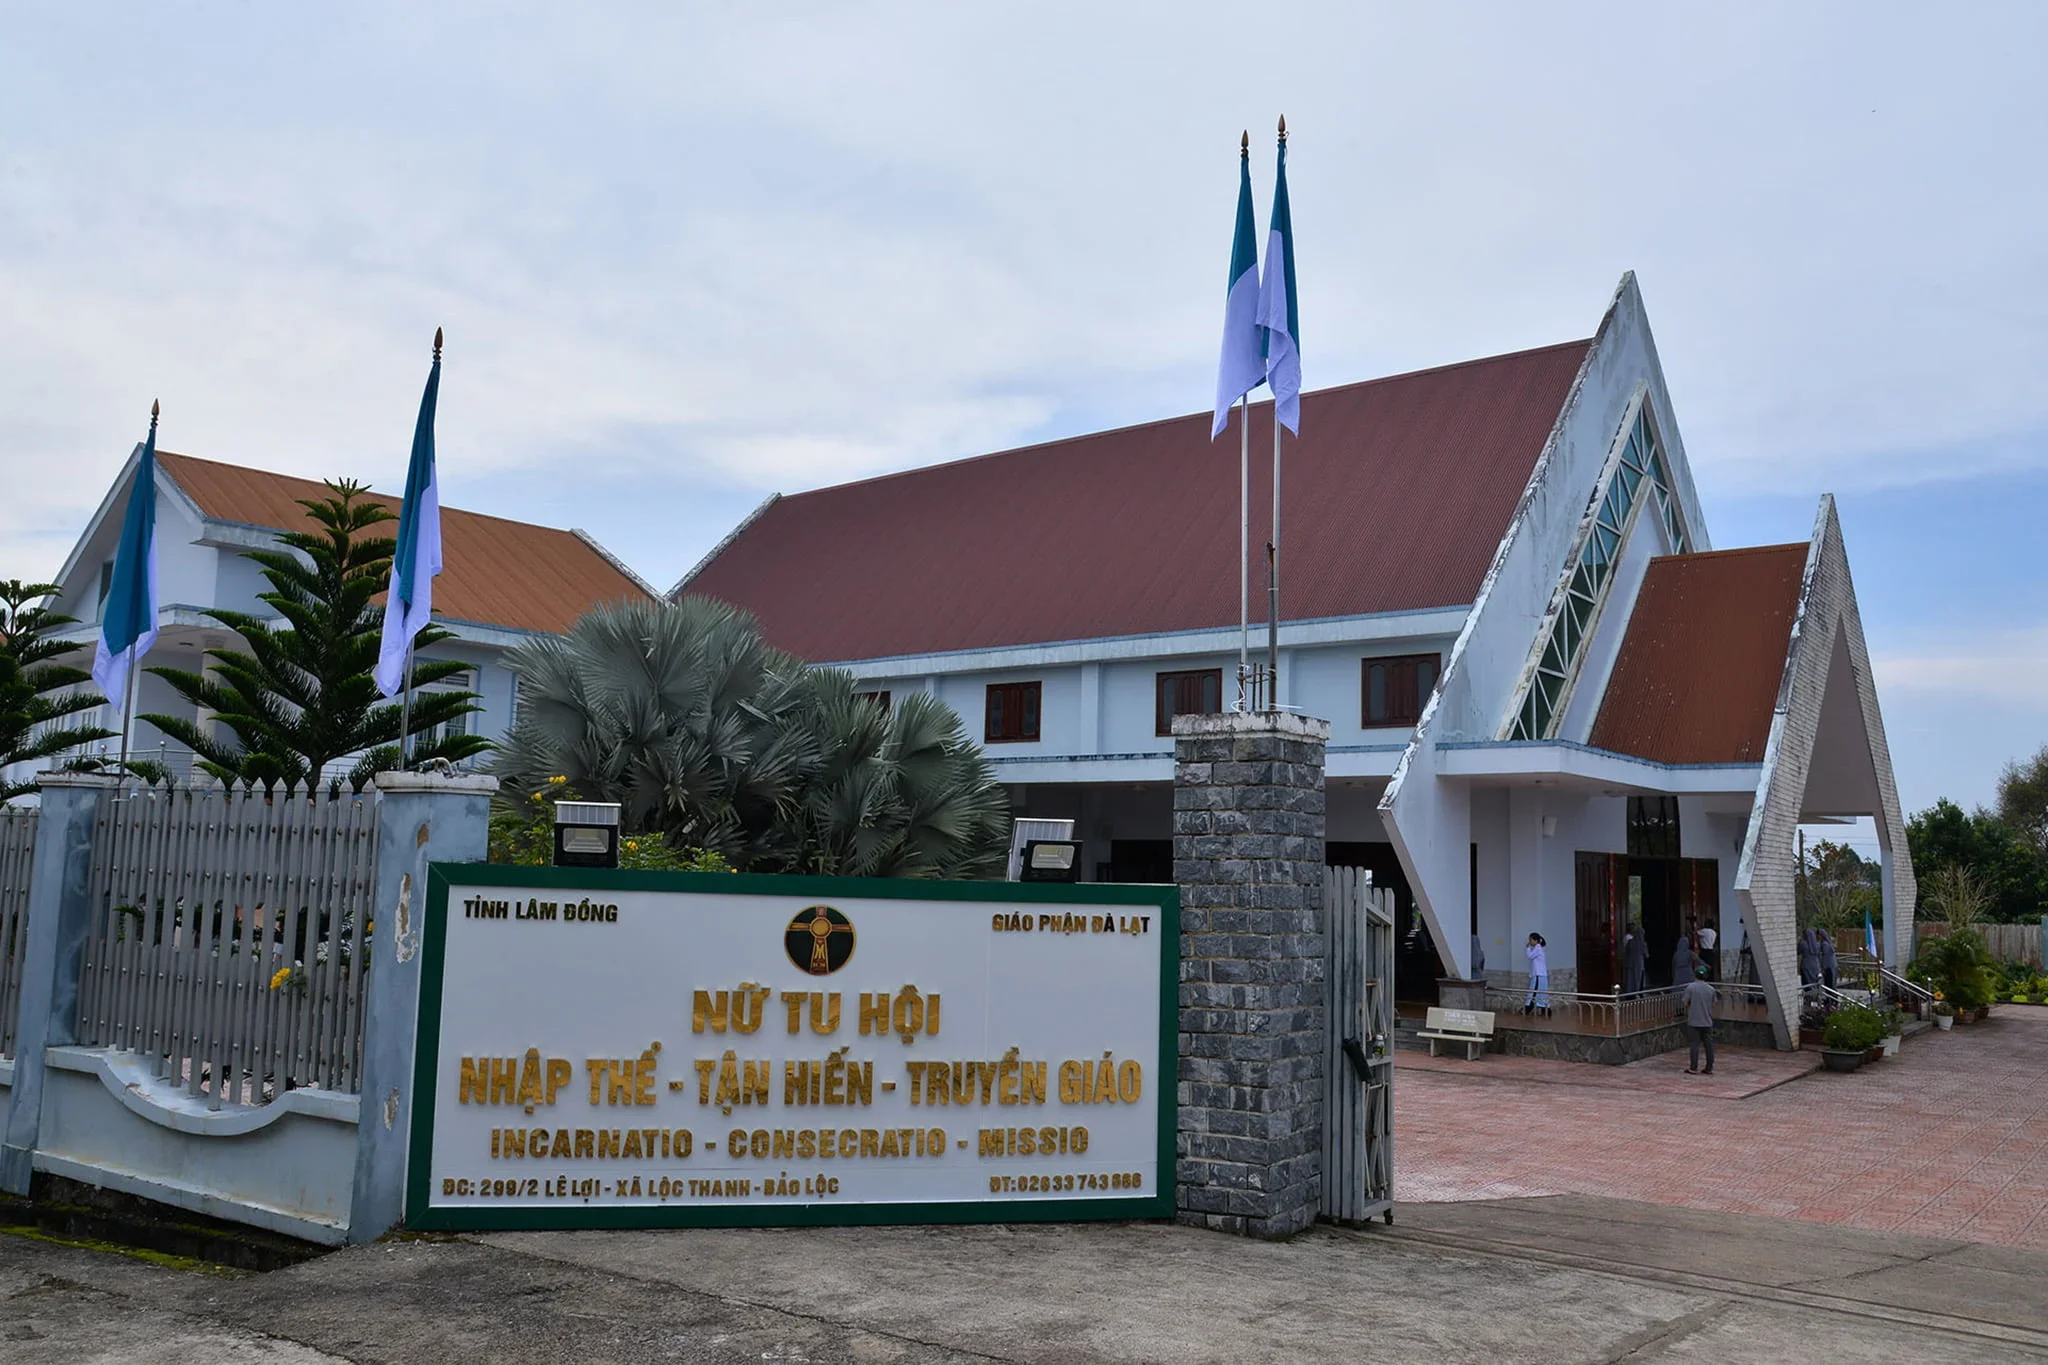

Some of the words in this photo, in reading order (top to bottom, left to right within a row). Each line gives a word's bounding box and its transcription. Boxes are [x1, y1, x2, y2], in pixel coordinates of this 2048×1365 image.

[464, 894, 508, 919] TỈNH
[515, 898, 557, 921] LÂM
[563, 897, 618, 922] ĐỒNG
[992, 911, 1034, 931] GIÁO
[1039, 912, 1087, 935] PHẬN
[1091, 912, 1115, 933] ĐÀ
[1120, 915, 1150, 936] LẠT
[692, 982, 771, 1034] NỮ
[780, 991, 842, 1034] TU
[858, 984, 941, 1045] HỘI
[459, 1048, 572, 1115] NHẬP
[586, 1041, 662, 1105] THỂ
[694, 1050, 771, 1115] TẬN
[784, 1046, 873, 1105] HIẾN
[906, 1046, 1047, 1105] TRUYỀN
[1058, 1050, 1142, 1104] GIÁO
[490, 1128, 693, 1159] INCARNATIO
[728, 1127, 947, 1158] CONSECRATIO
[978, 1126, 1089, 1157] MISSIO
[442, 1178, 475, 1196] ĐC:
[479, 1178, 539, 1196] 299/2
[545, 1175, 567, 1197] LÊ
[571, 1177, 600, 1203] LỢI
[615, 1176, 642, 1197] XÃ
[648, 1176, 683, 1201] LỘC
[688, 1179, 750, 1197] THANH
[763, 1171, 800, 1196] BẢO
[805, 1173, 839, 1198] LỘC
